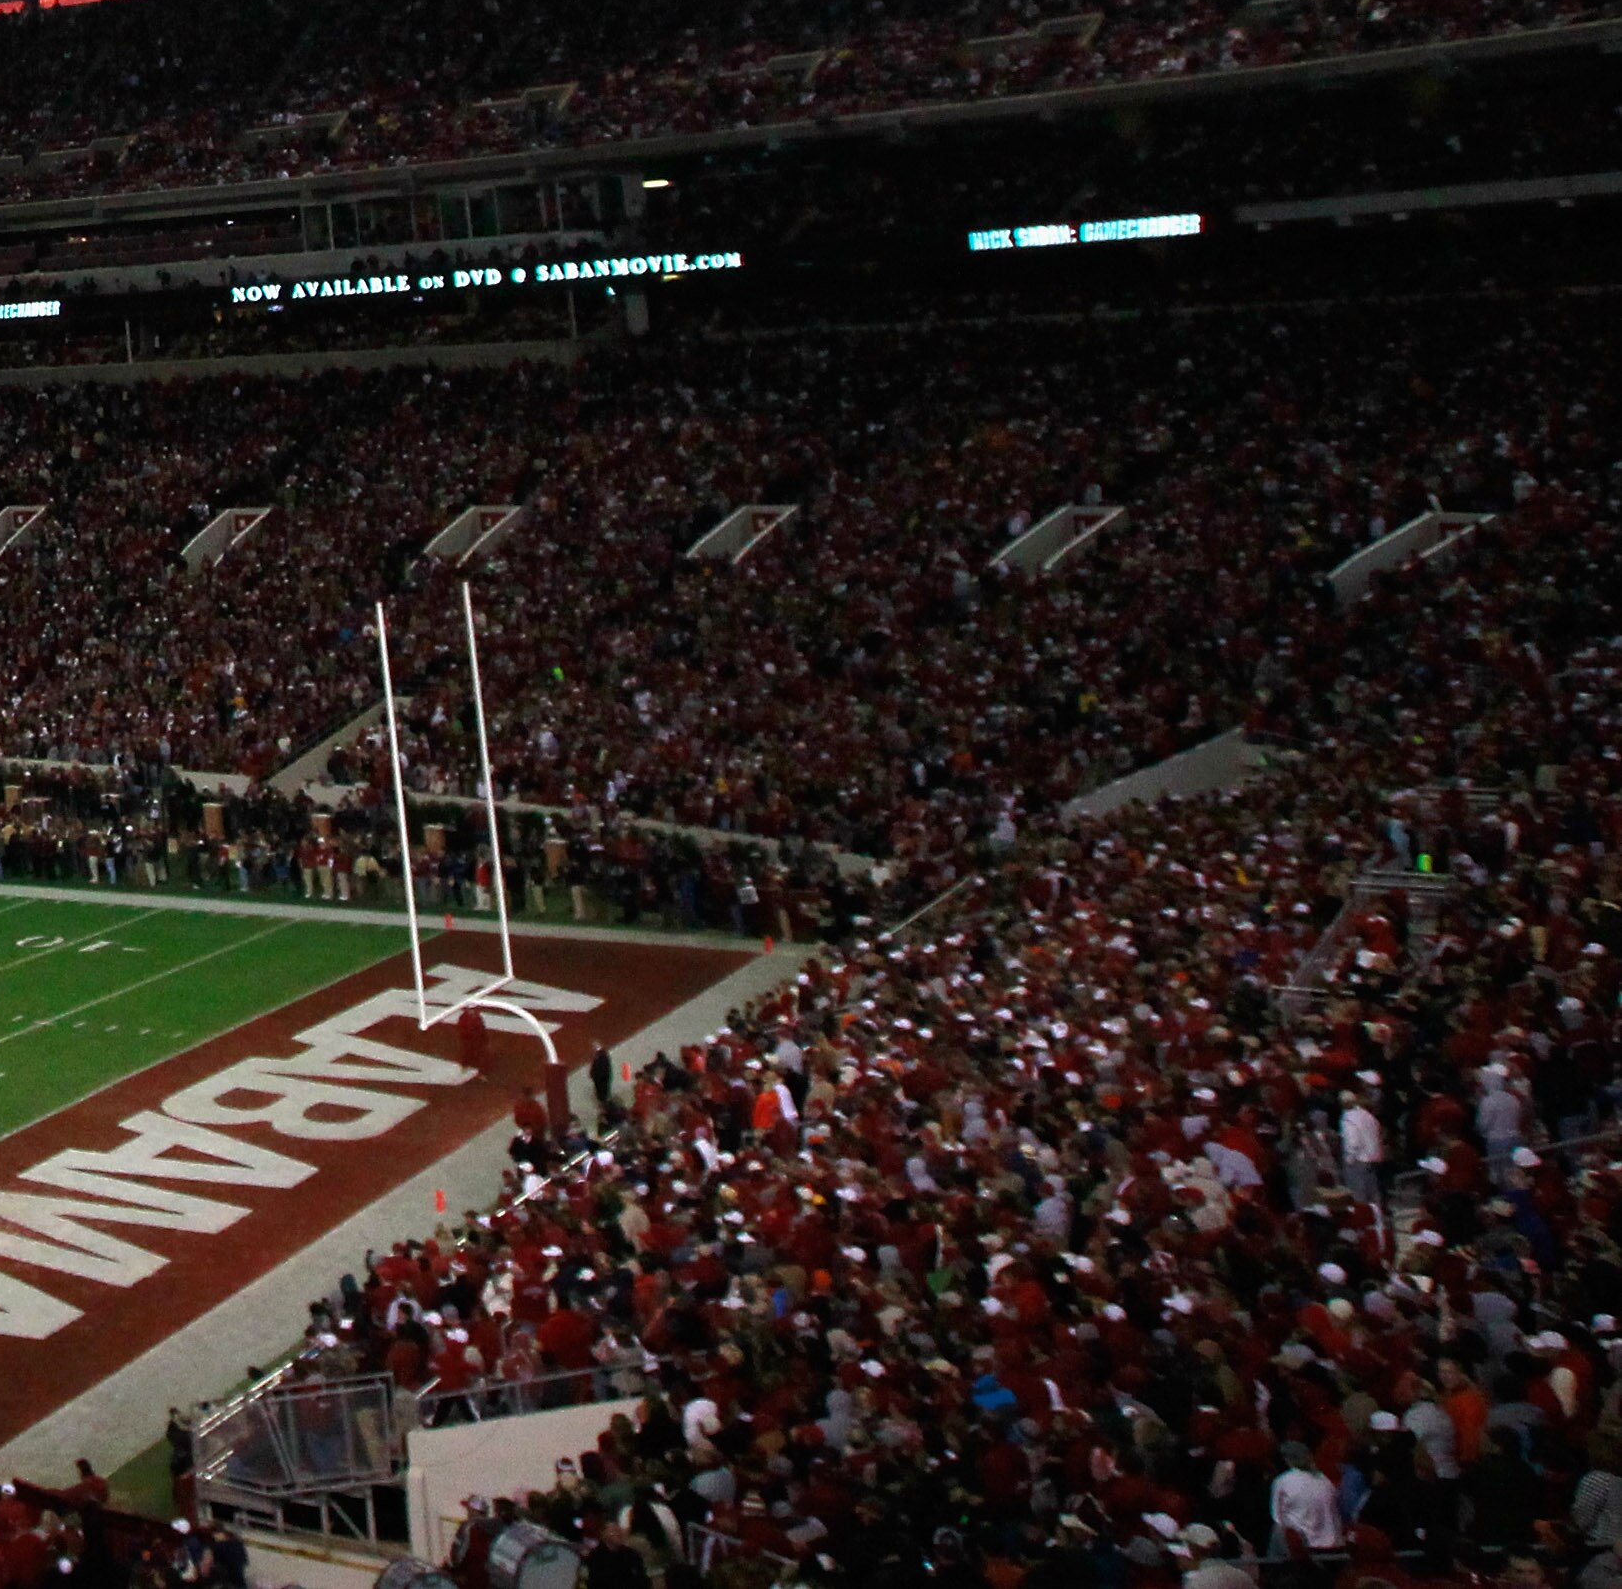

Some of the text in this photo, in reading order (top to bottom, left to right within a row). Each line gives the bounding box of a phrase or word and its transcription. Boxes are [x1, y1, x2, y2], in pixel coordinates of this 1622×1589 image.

[968, 229, 1013, 251] NICK
[231, 285, 282, 303] NOW
[292, 275, 411, 299] AVAILABLE
[454, 269, 502, 288] DVD
